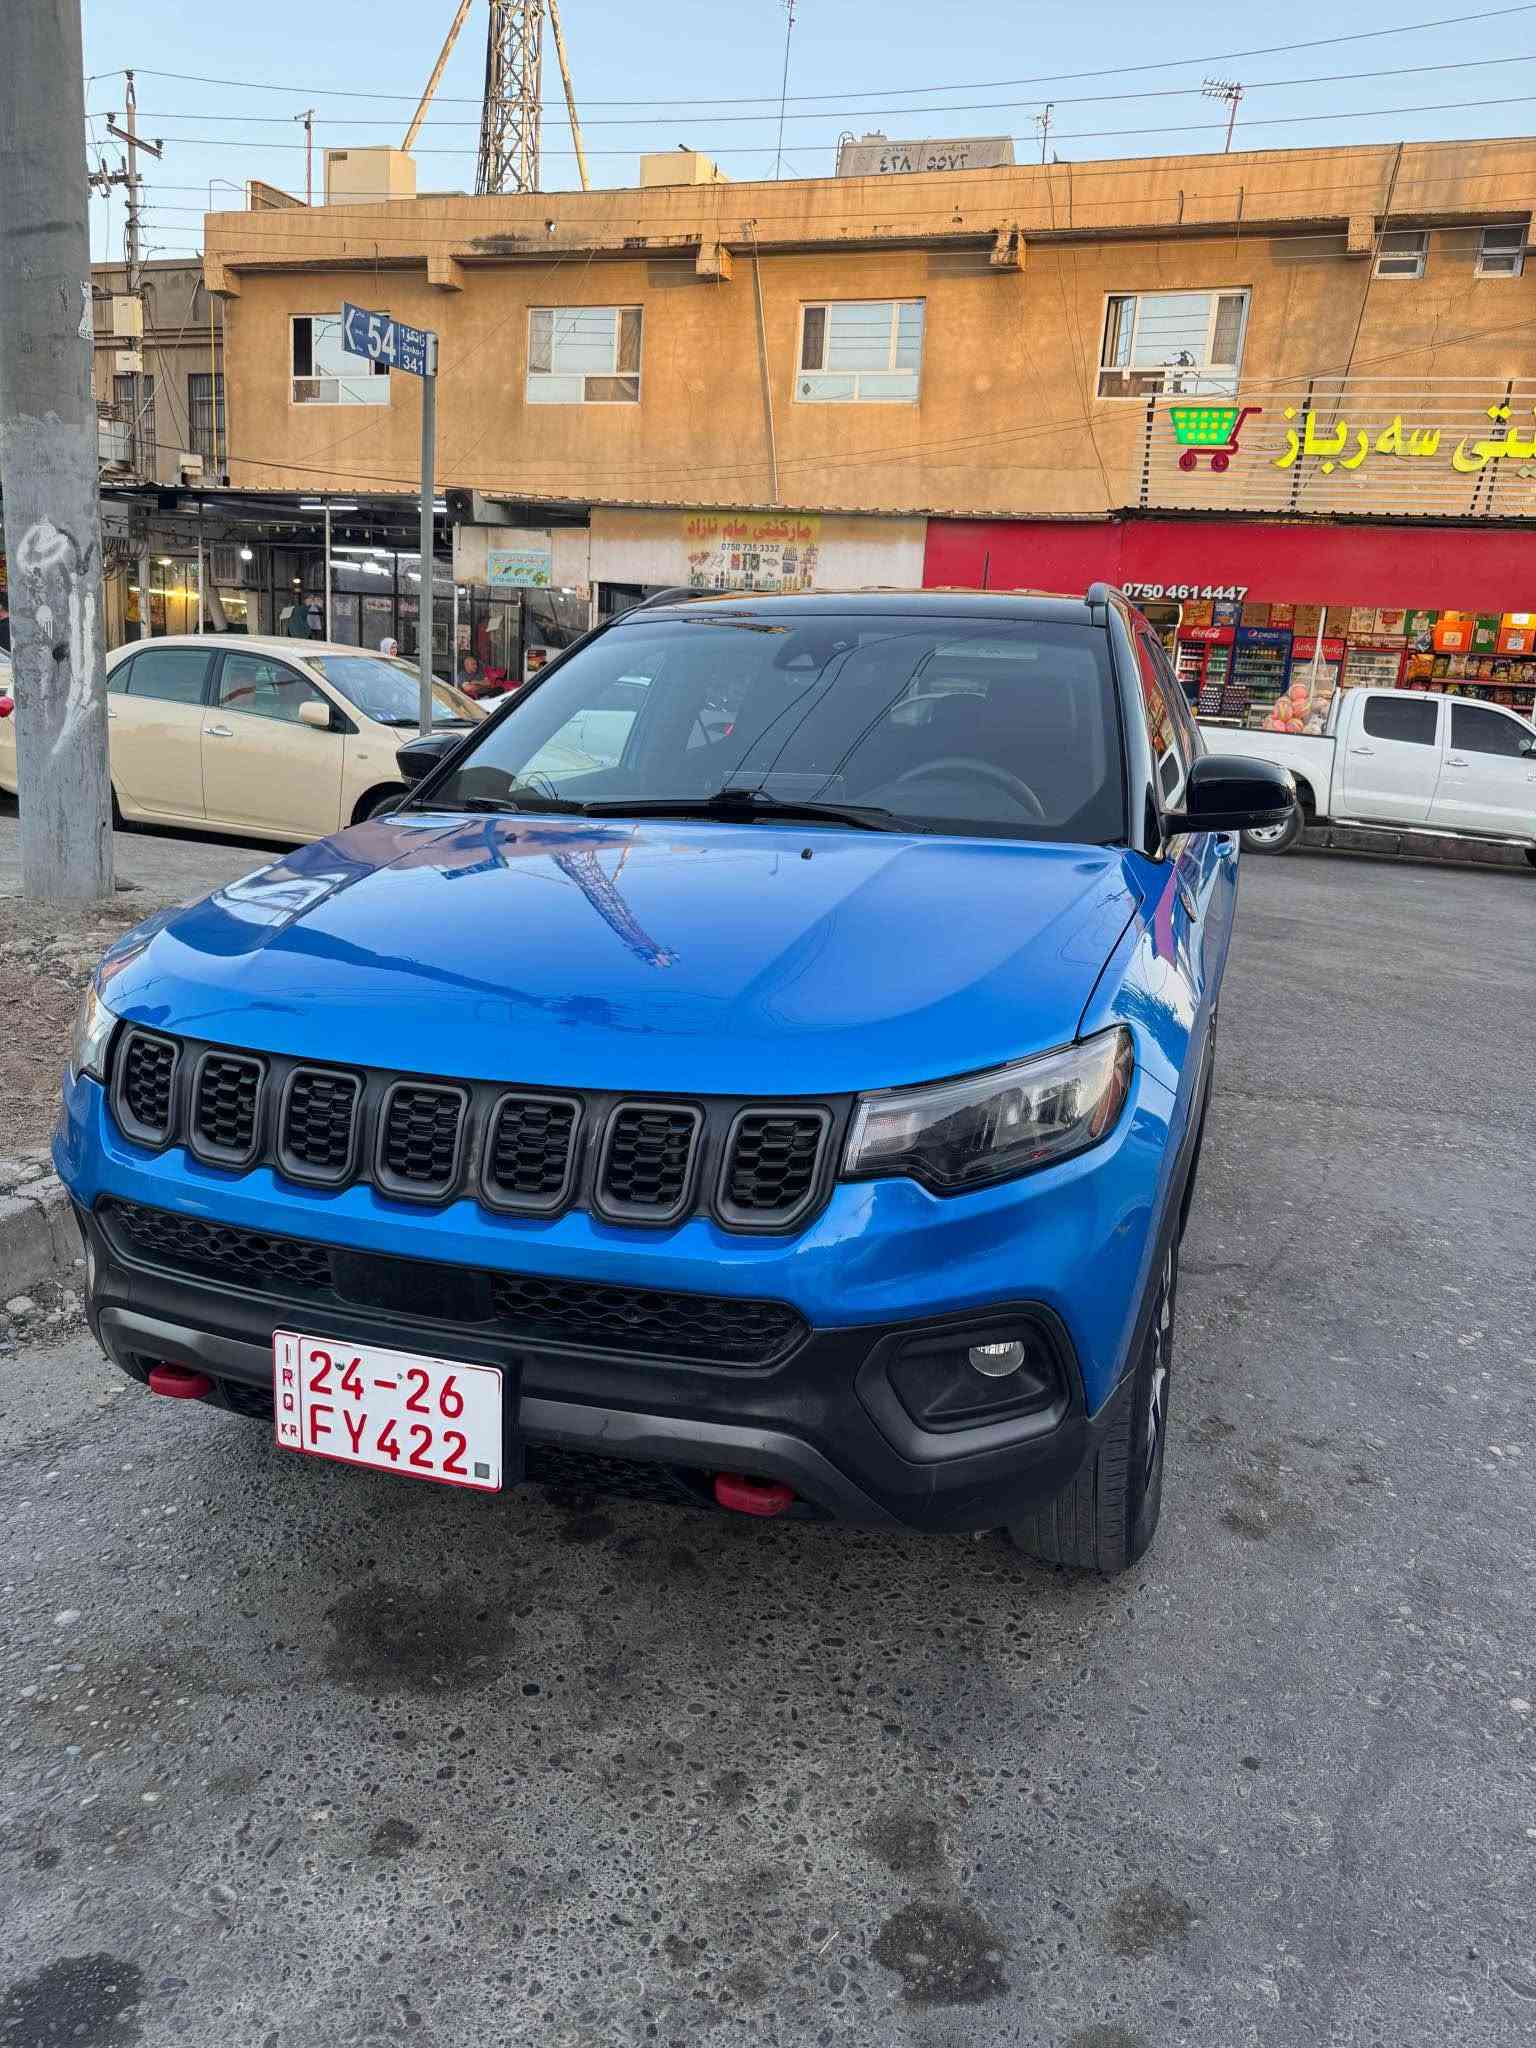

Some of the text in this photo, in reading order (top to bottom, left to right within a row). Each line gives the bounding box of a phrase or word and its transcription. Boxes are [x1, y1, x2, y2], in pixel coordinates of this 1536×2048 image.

[367, 315, 397, 363] 54
[403, 355, 424, 375] 341
[280, 1422, 298, 1438] KR
